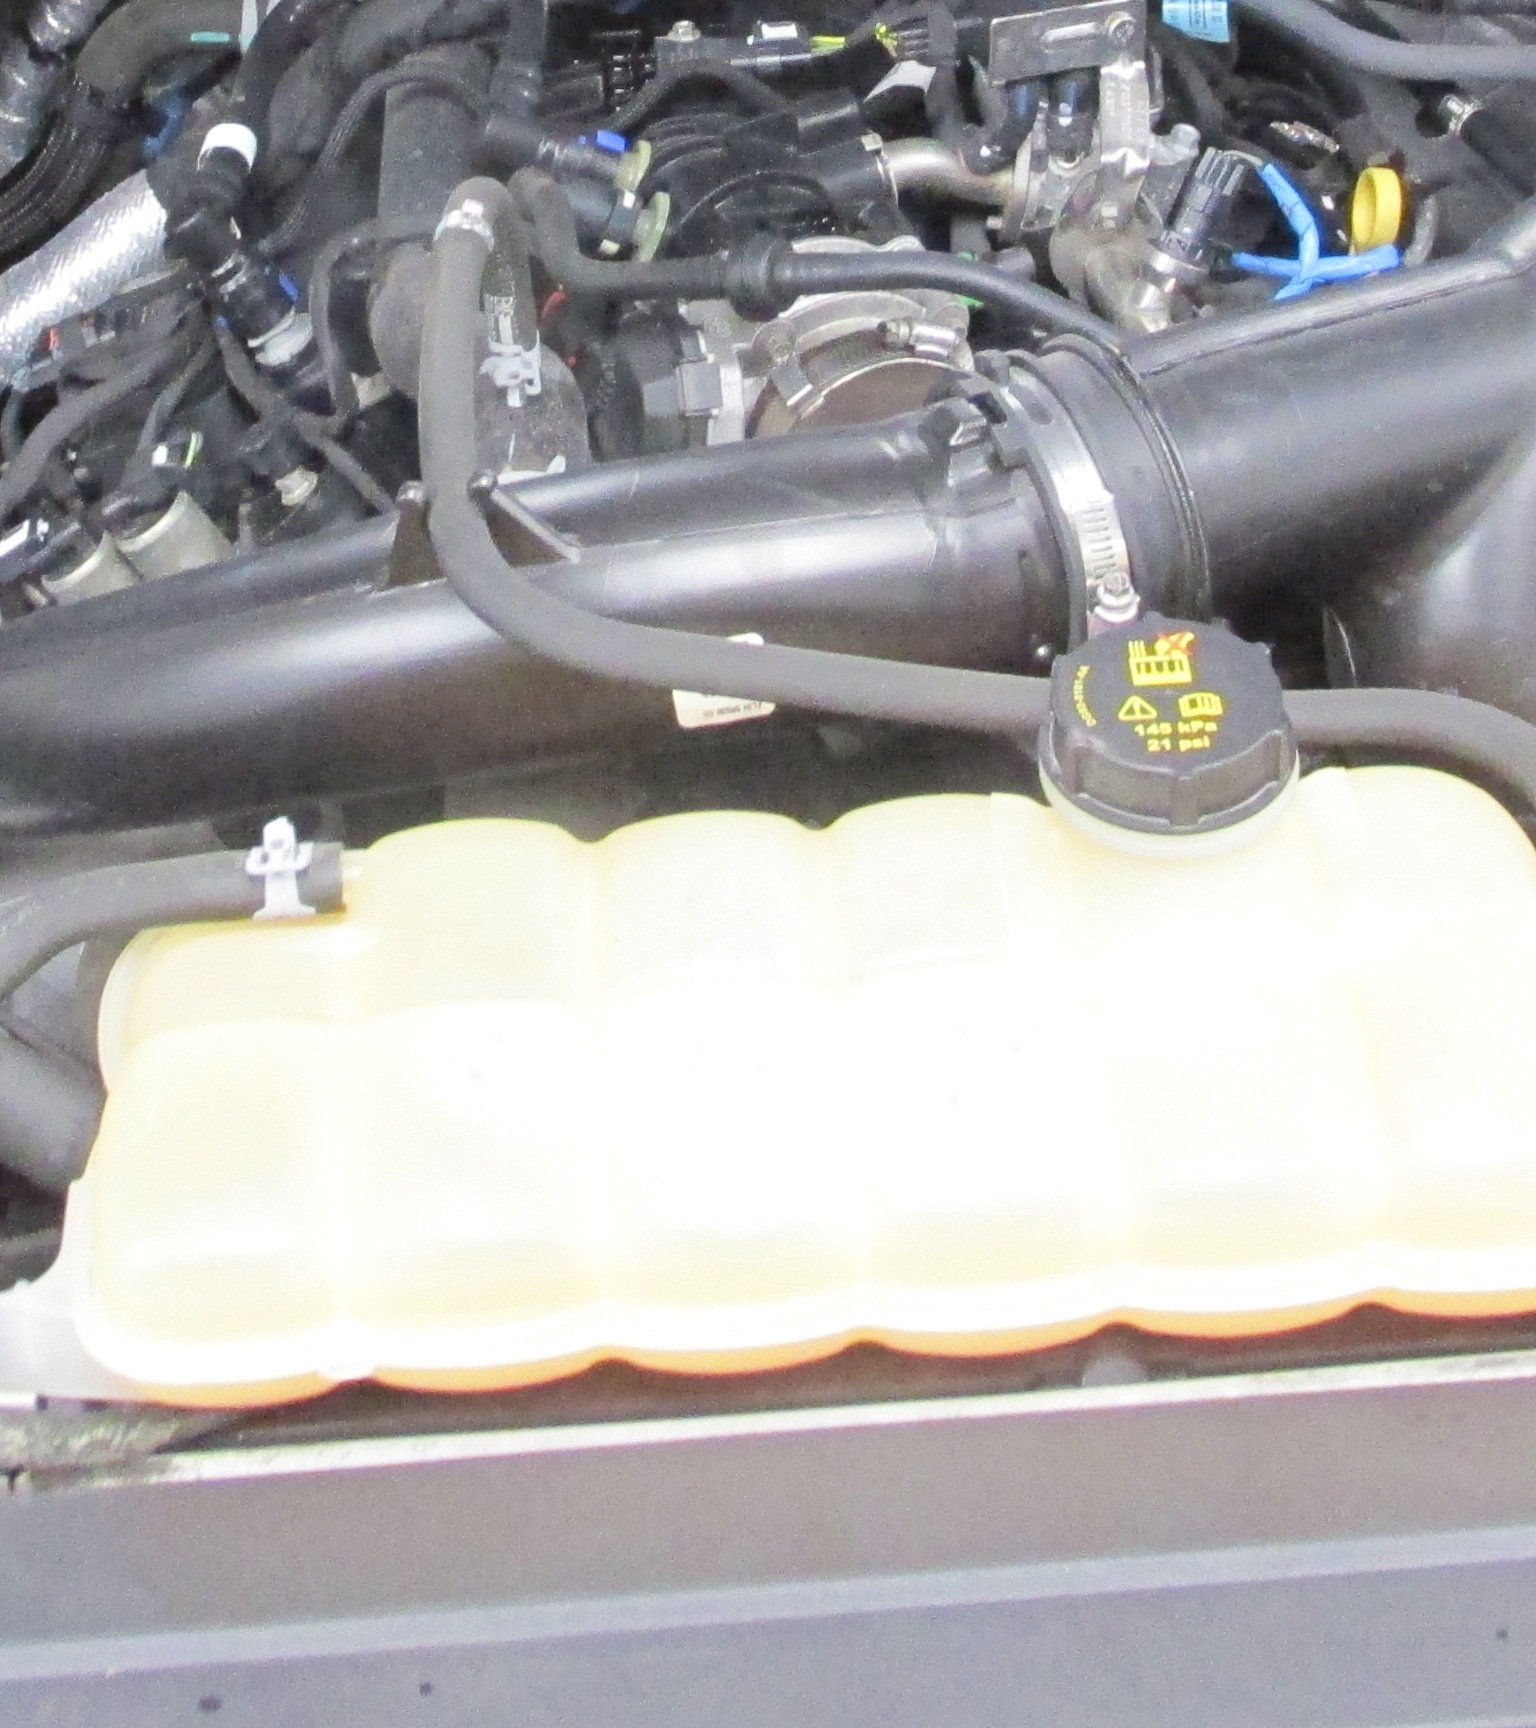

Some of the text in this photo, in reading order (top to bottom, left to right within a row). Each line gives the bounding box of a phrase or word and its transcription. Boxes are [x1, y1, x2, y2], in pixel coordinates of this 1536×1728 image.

[1177, 719, 1218, 734] kPa
[1147, 735, 1211, 753] 21 psi
